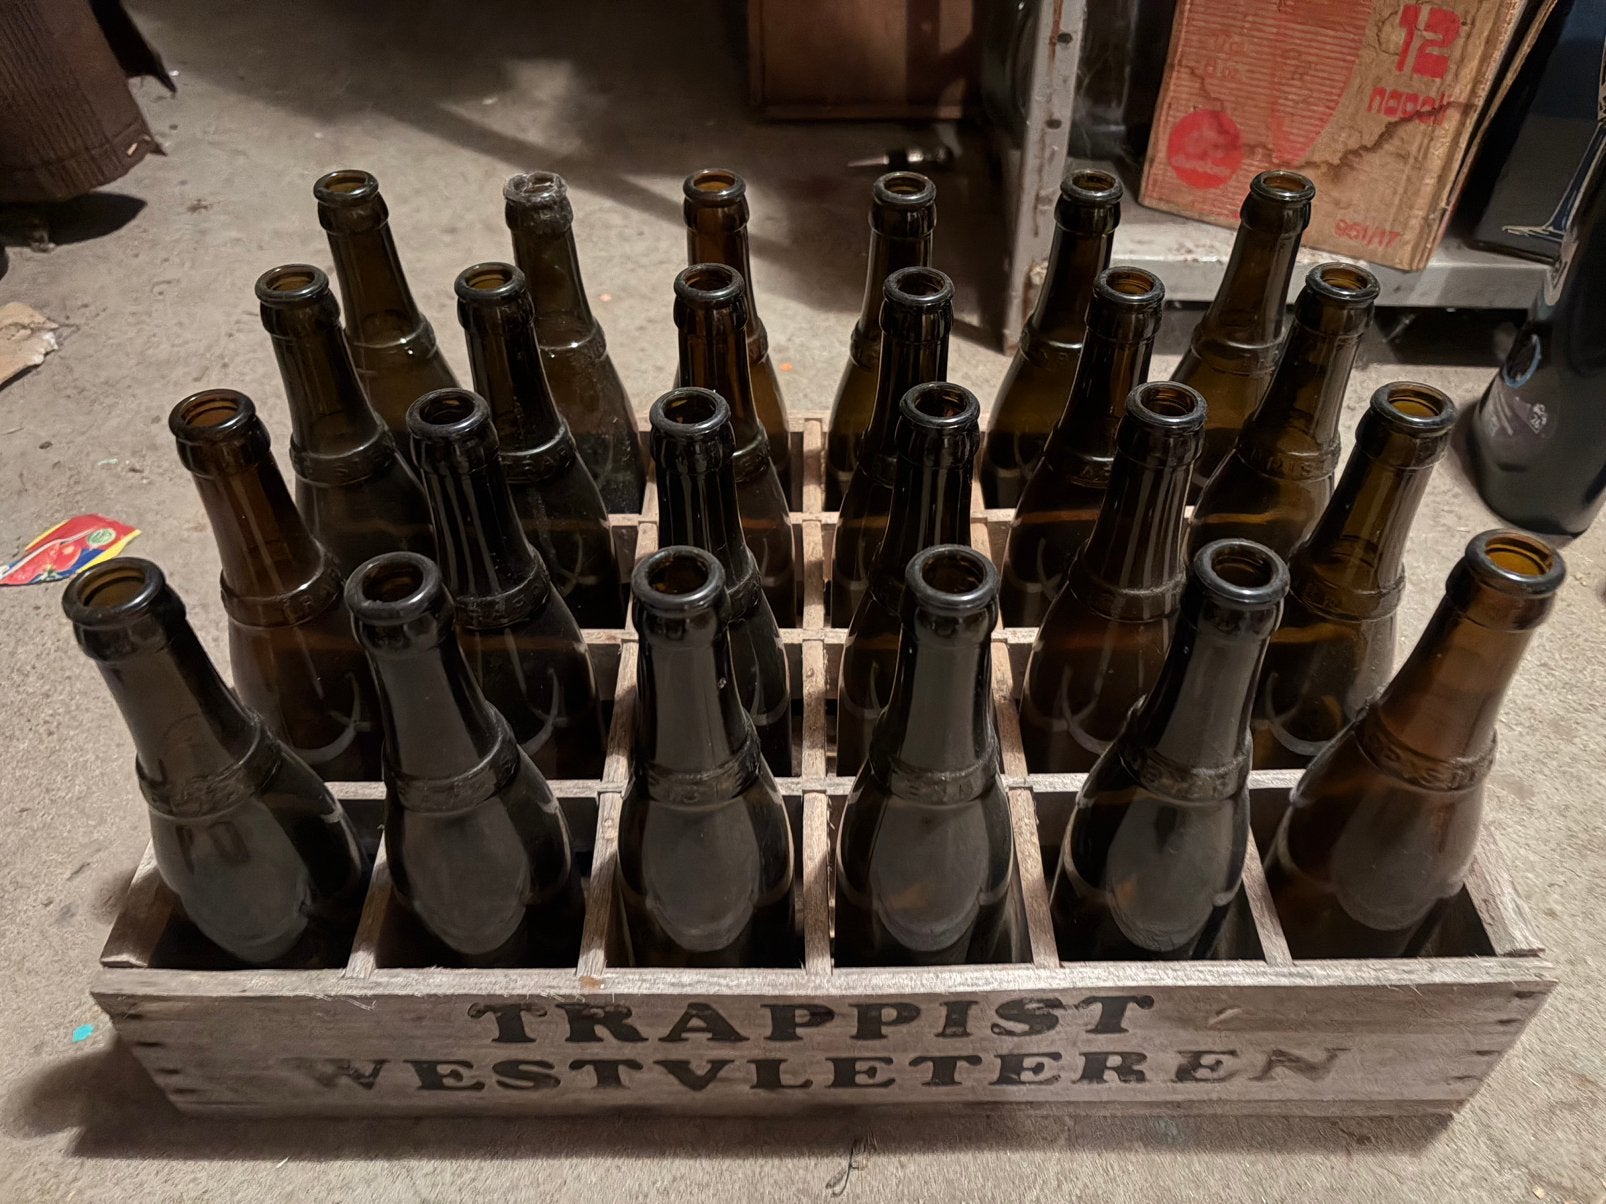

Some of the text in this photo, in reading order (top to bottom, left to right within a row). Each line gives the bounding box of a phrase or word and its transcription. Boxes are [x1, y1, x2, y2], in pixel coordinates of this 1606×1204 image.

[1395, 4, 1461, 80] 12
[467, 995, 1154, 1042] TRAPPIST
[284, 1048, 1350, 1092] WESTVLETEREN
